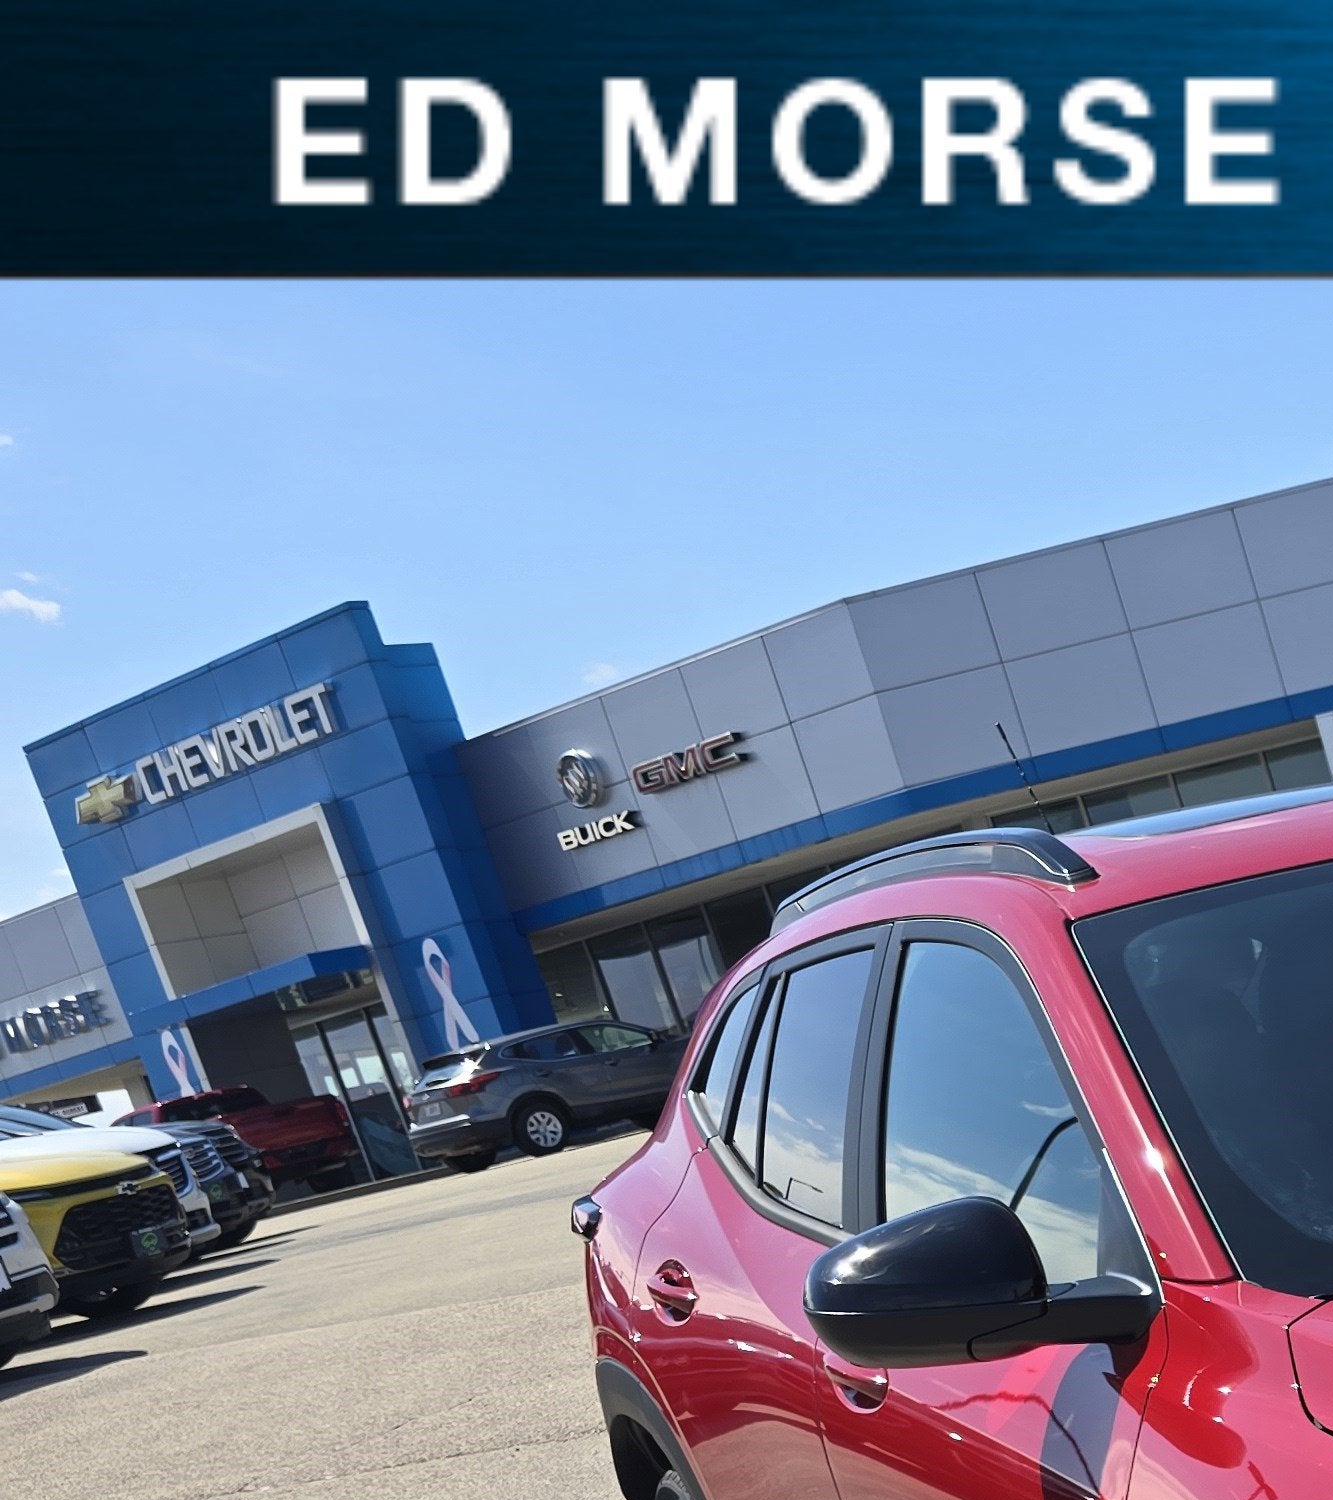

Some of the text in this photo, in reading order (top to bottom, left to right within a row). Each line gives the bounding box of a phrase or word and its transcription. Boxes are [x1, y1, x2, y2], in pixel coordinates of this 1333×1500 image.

[135, 681, 335, 805] CHEVROLET
[630, 731, 741, 795] GMC
[556, 809, 636, 852] BUICK
